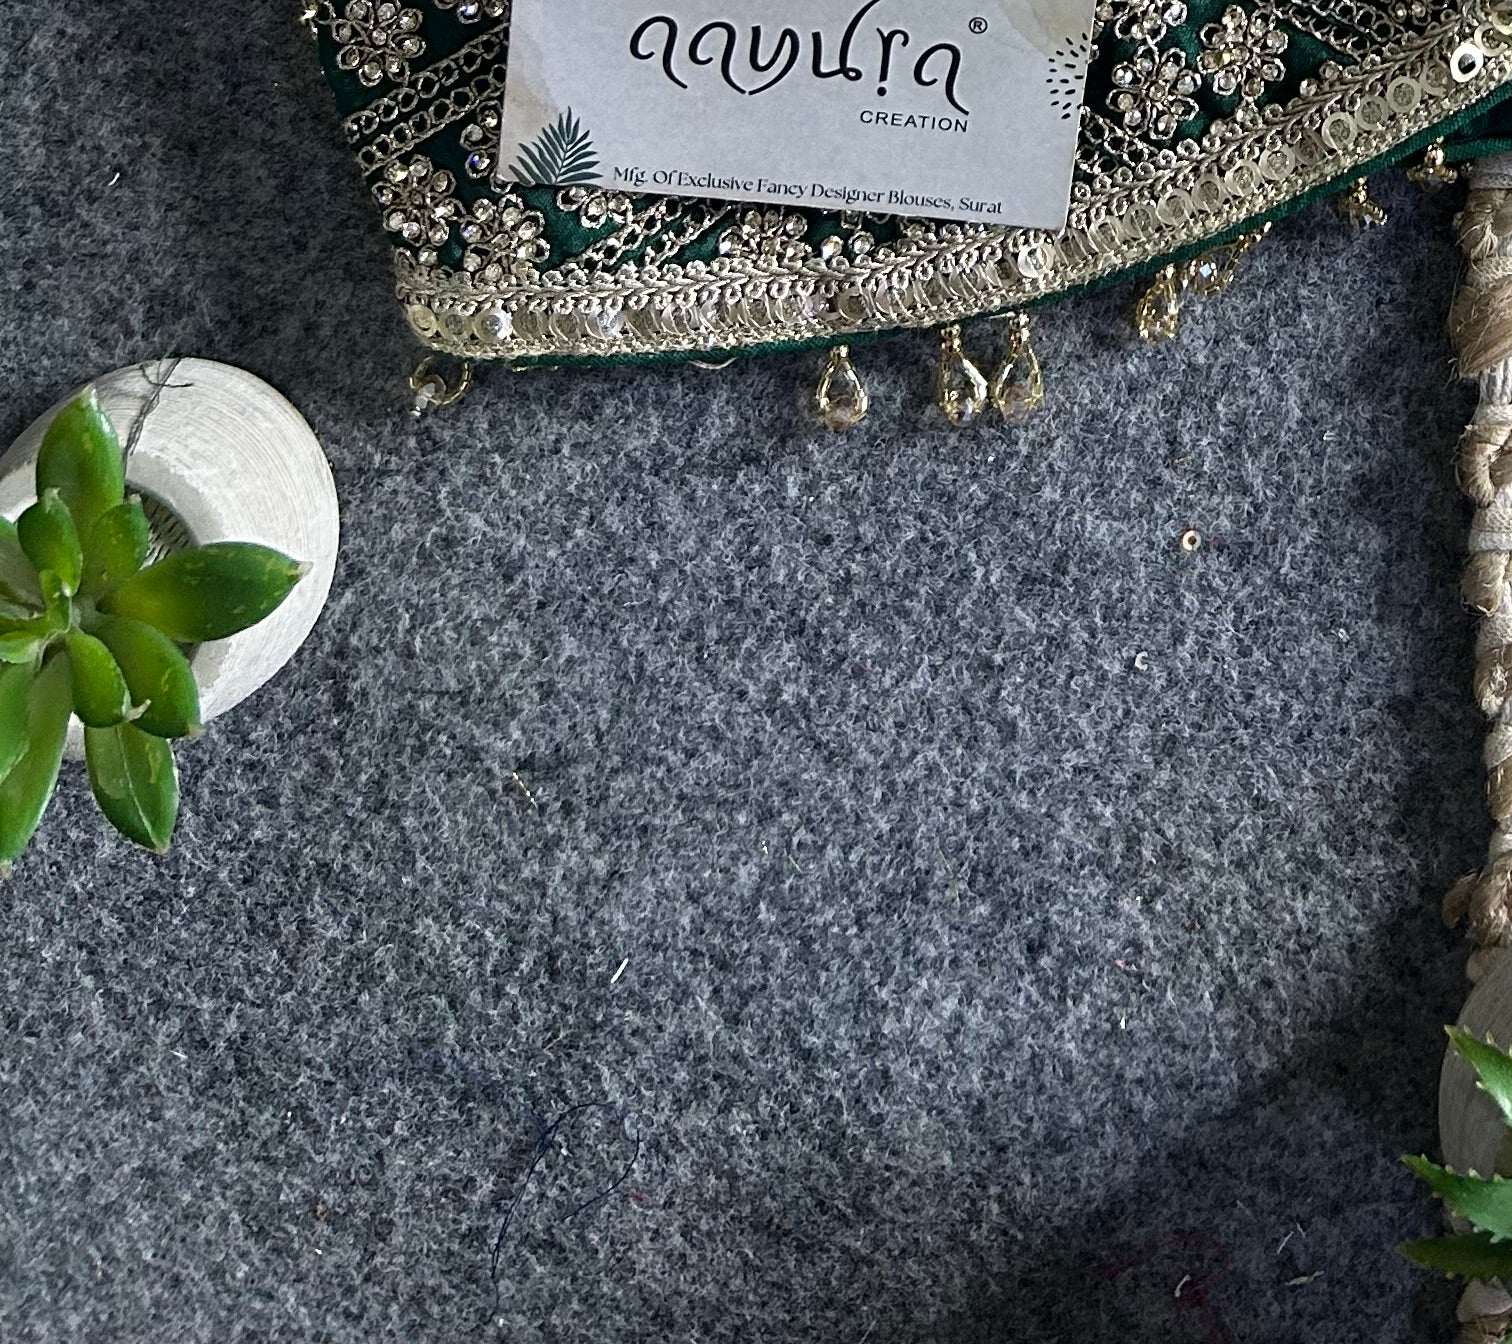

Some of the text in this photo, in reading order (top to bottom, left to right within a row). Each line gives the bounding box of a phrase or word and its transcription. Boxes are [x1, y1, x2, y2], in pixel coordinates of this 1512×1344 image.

[860, 110, 969, 133] CREATION
[613, 166, 1003, 215] Mfg. Of Exclusive Fancy Designer Blouses, Surat
